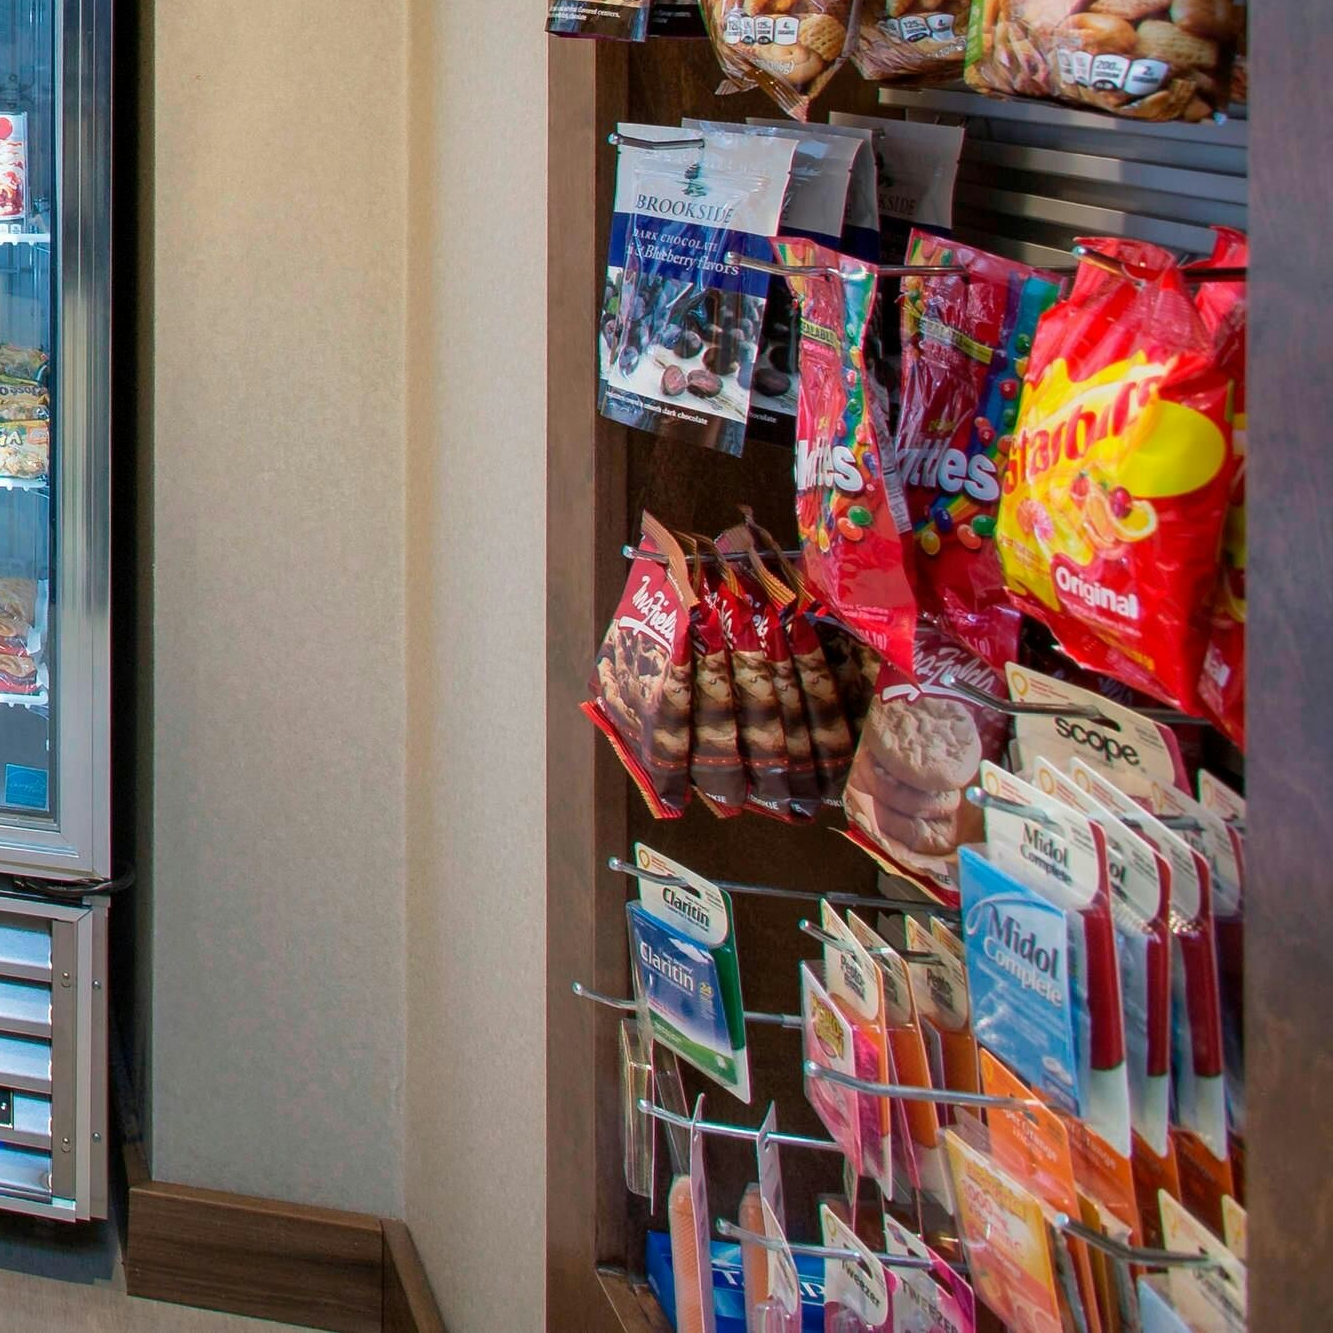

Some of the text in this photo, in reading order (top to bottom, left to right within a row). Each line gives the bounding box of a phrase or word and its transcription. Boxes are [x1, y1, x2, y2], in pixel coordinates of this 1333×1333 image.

[636, 193, 734, 224] BROOKSIDE
[633, 227, 719, 252] DARK CHOCOLATE
[645, 244, 741, 277] Blueberry flavors
[677, 409, 709, 426] chocolate
[1055, 565, 1139, 620] Original
[1054, 716, 1141, 766] scope
[1021, 821, 1070, 869] Midol
[661, 886, 710, 928] Claritin
[988, 903, 1059, 980] Midol
[639, 941, 694, 993] Claritin
[984, 936, 1063, 1008] Complete
